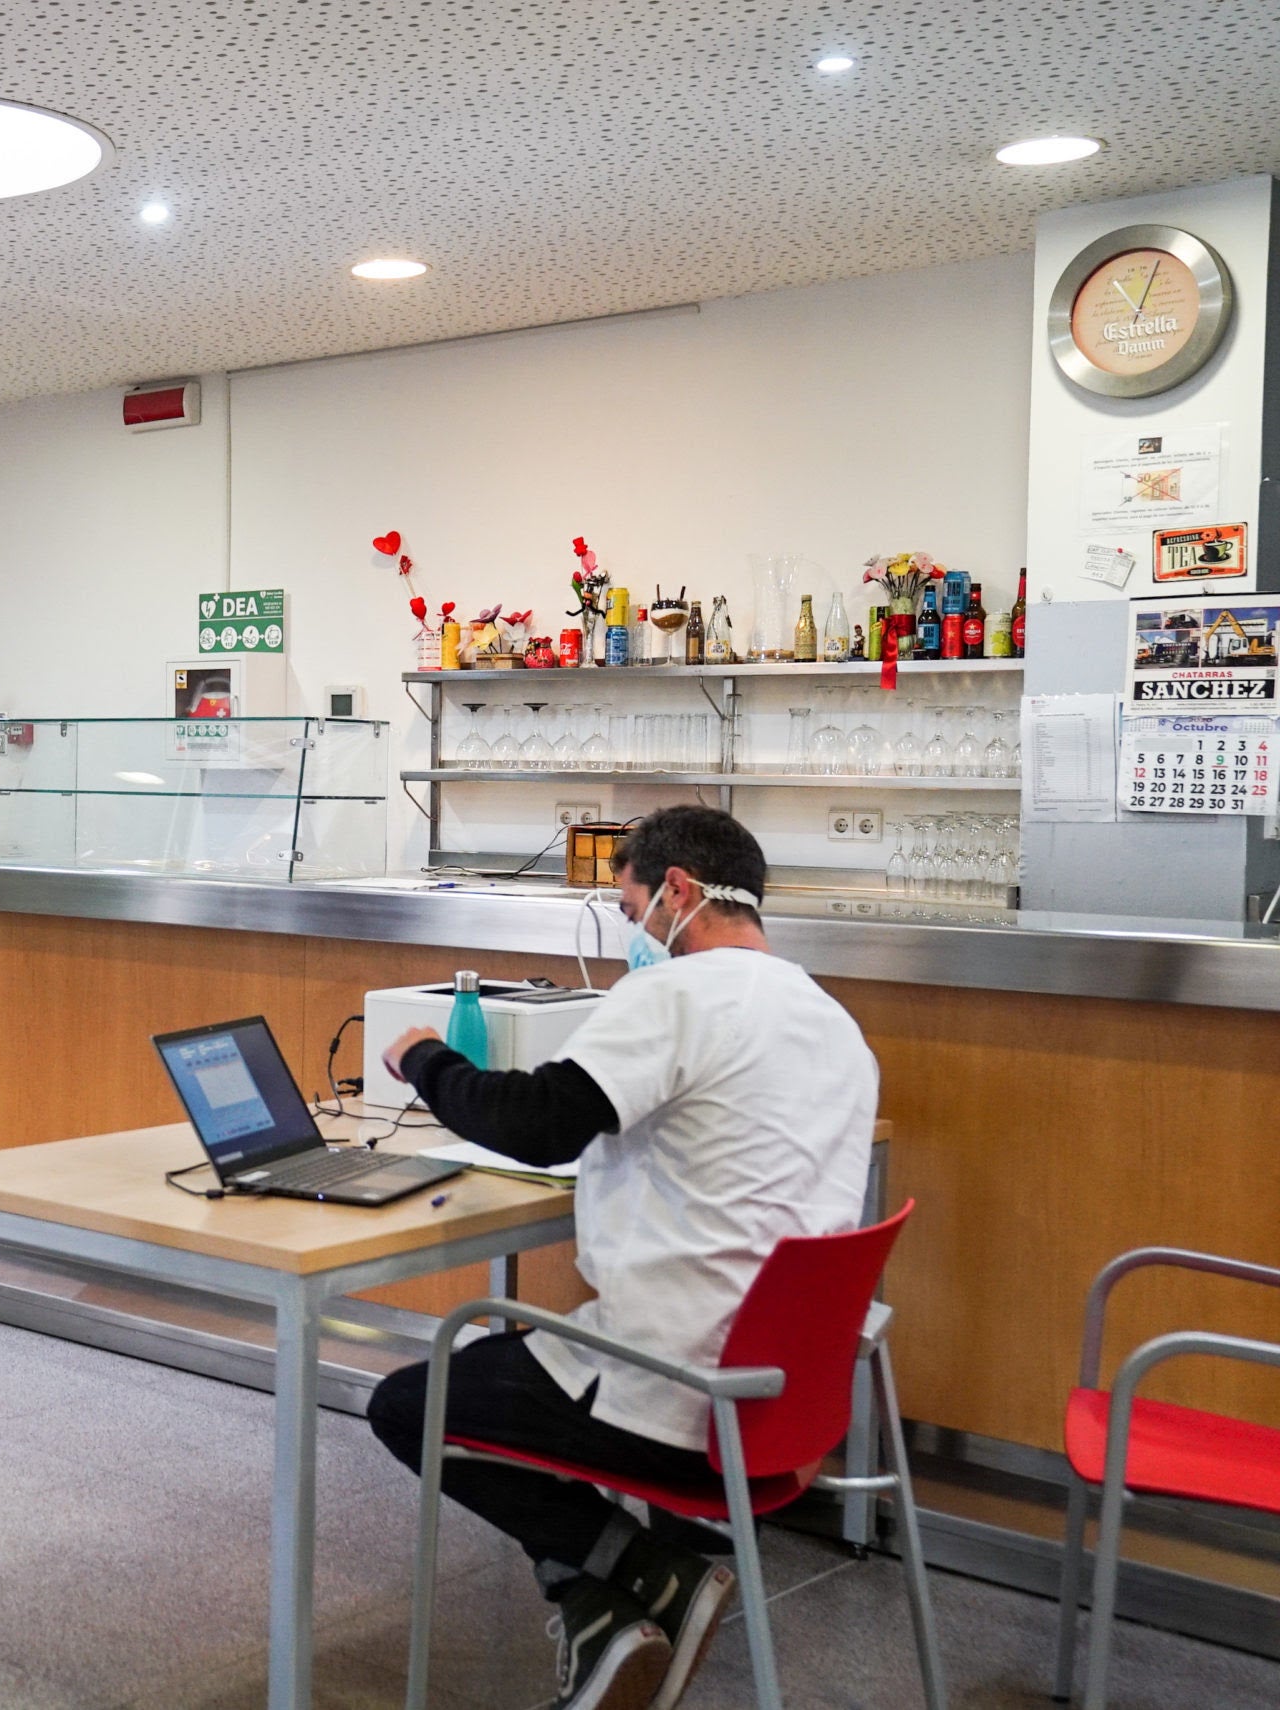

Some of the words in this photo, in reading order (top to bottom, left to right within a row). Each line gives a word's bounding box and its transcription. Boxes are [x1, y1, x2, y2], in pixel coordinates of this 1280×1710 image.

[1103, 316, 1178, 342] Estrella
[1116, 338, 1165, 355] Damm
[1167, 546, 1197, 569] TEA
[222, 597, 258, 616] DEA
[1171, 671, 1233, 679] CHATARRAS
[1141, 681, 1266, 699] SANCHEZ
[1172, 723, 1228, 732] Octubre
[1197, 740, 1202, 750] 1
[1217, 741, 1225, 750] 2
[1238, 741, 1246, 751] 3
[1258, 742, 1268, 751] 4
[1137, 754, 1145, 763] 5
[1156, 754, 1164, 764] 6
[1176, 755, 1184, 764] 7
[1195, 755, 1203, 764] 8
[1216, 756, 1224, 765] 9
[1234, 756, 1248, 765] 10
[1256, 756, 1267, 766] 11
[1134, 768, 1146, 778] 12
[1153, 768, 1165, 778] 13
[1173, 769, 1186, 778] 14
[1193, 770, 1204, 779] 15
[1213, 770, 1226, 779] 16
[1234, 770, 1246, 780] 17
[1254, 771, 1267, 781] 18
[1133, 782, 1144, 792] 19
[1150, 783, 1166, 792] 20
[1172, 784, 1184, 793] 21
[1190, 784, 1204, 794] 22
[1210, 785, 1226, 794] 23
[1231, 785, 1247, 795] 24
[1251, 786, 1267, 796] 25
[1130, 796, 1145, 806] 26
[1149, 797, 1164, 806] 27
[1169, 798, 1184, 807] 28
[1189, 798, 1204, 808] 29
[1209, 799, 1225, 809] 30
[1231, 800, 1244, 809] 31
